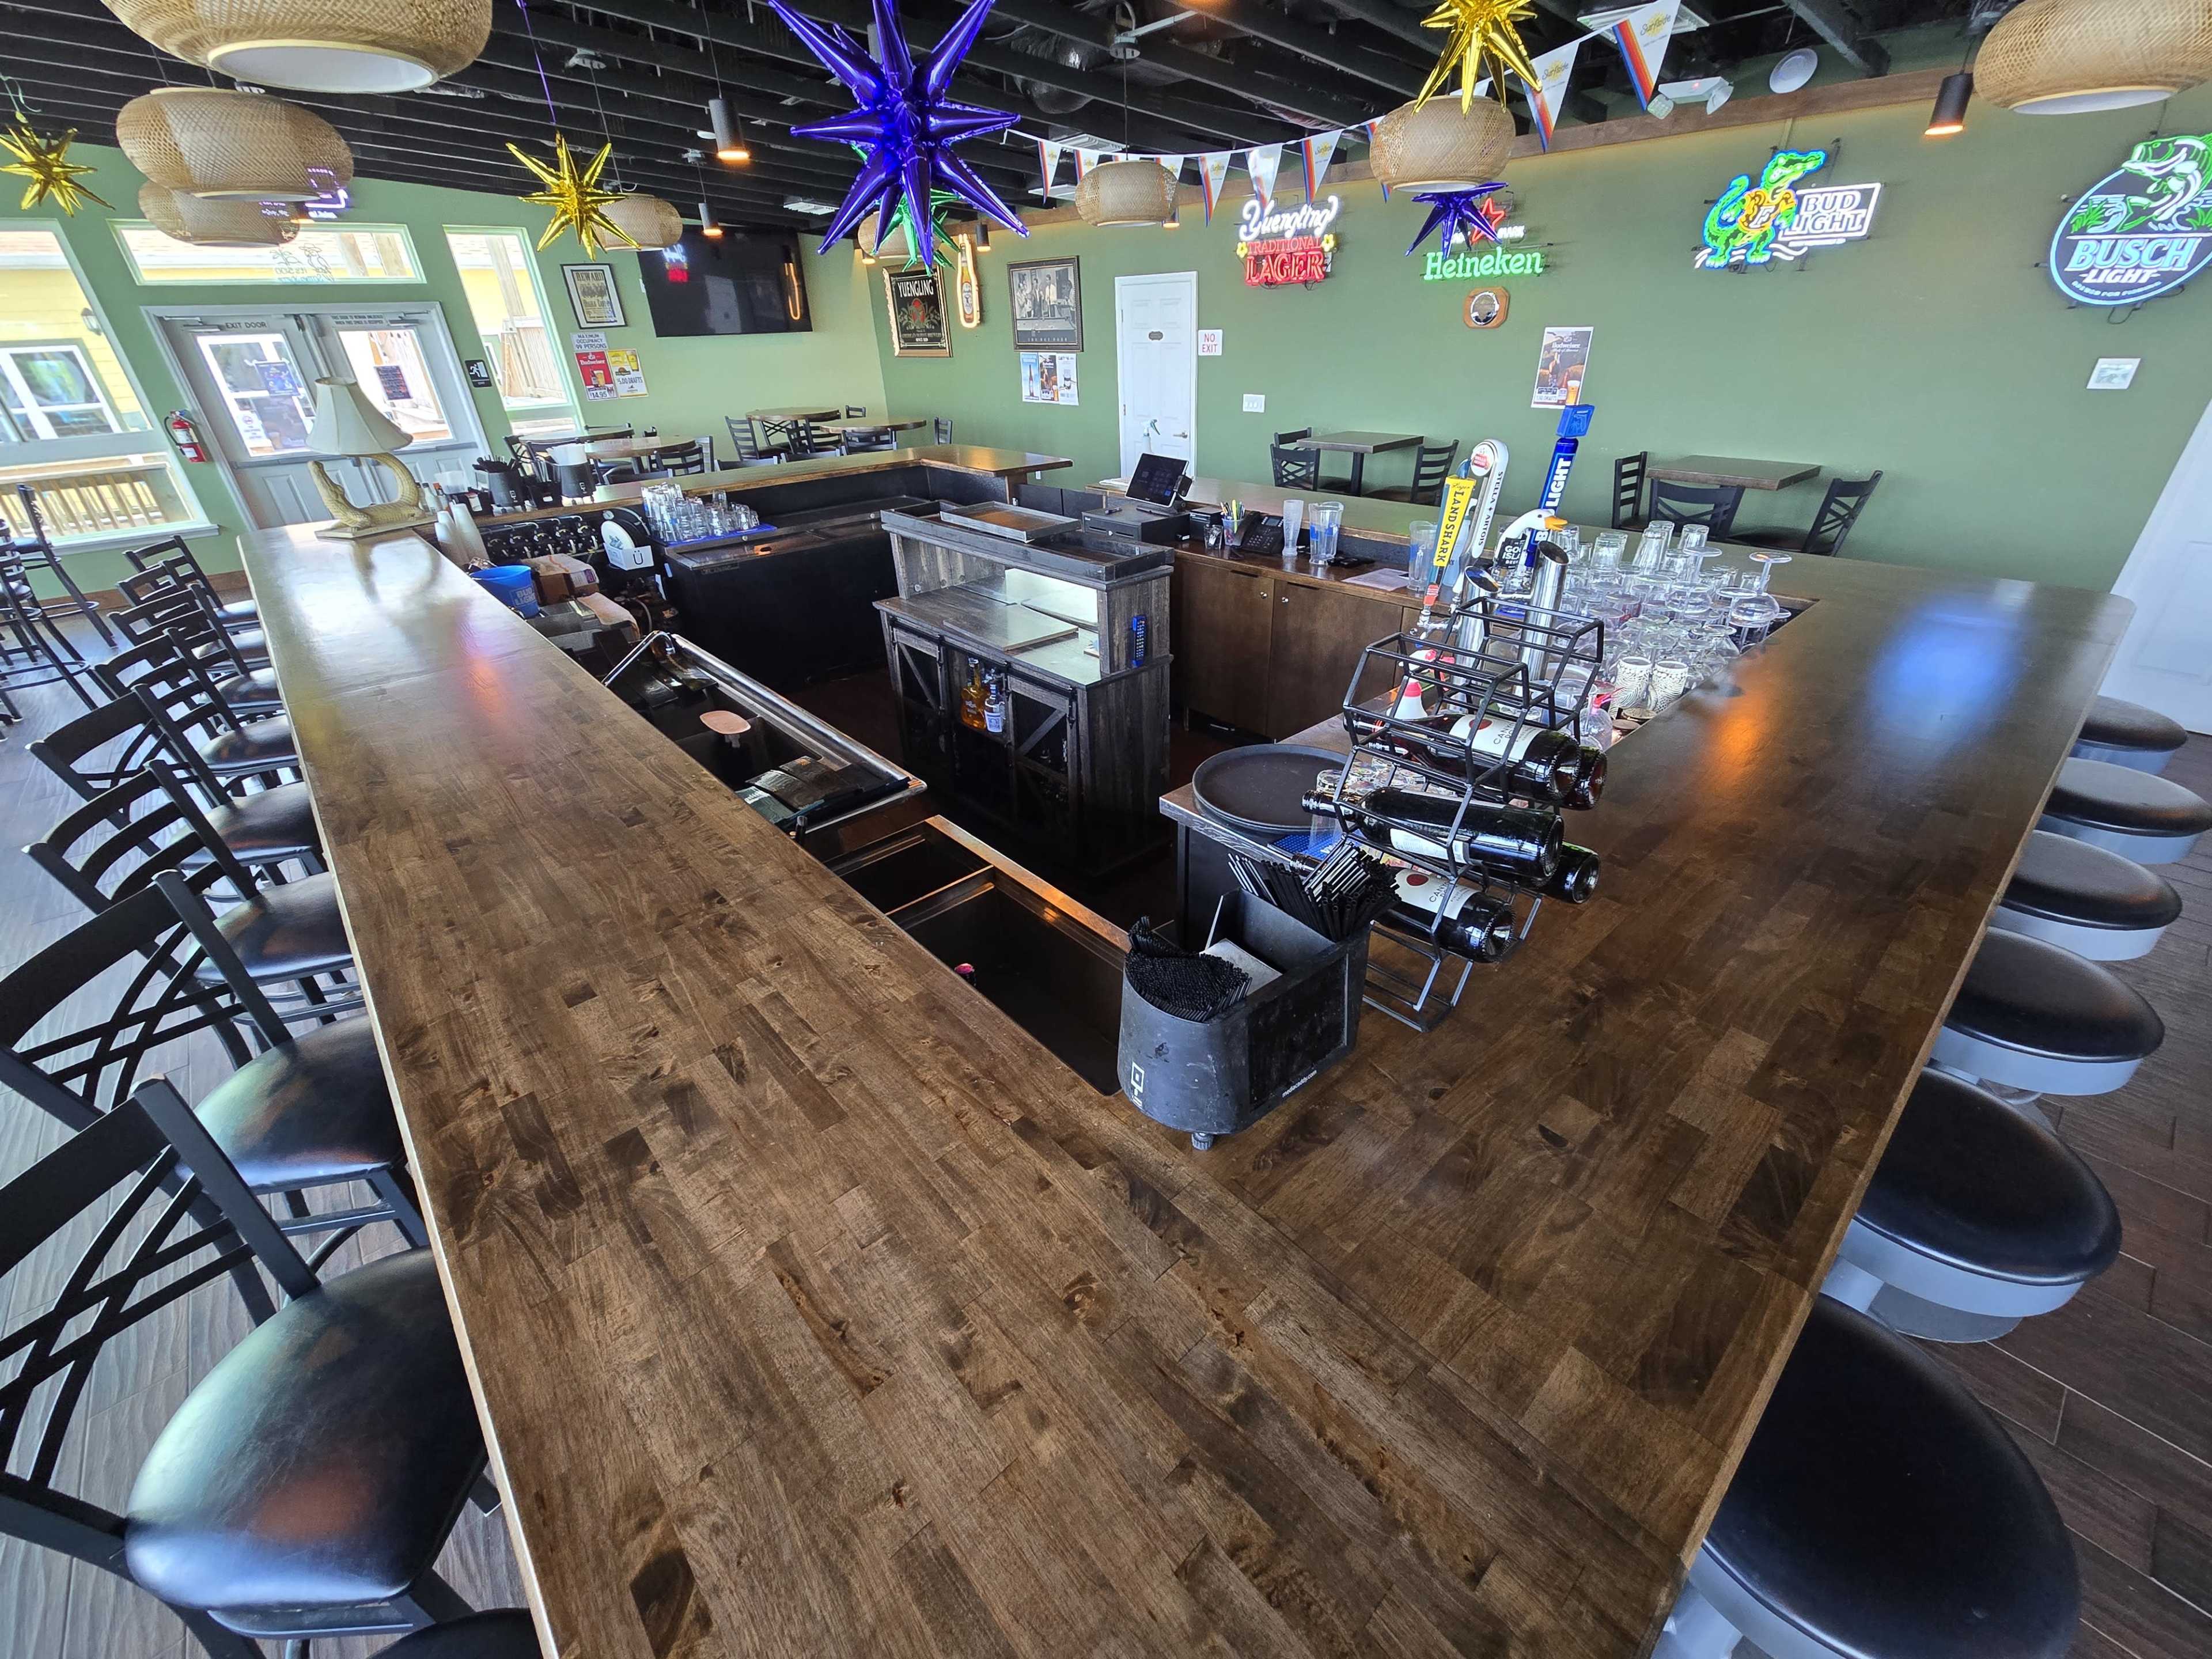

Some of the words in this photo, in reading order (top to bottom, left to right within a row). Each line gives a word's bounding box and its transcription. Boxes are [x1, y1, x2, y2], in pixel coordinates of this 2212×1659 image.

[1800, 191, 1861, 215] BUD
[1239, 195, 1339, 241] Yuengling
[1785, 209, 1868, 235] LIGHT
[1247, 236, 1322, 255] TRADITIONAL
[2064, 237, 2202, 271] BUSCH
[576, 272, 604, 281] REWARD
[1245, 251, 1325, 285] LAGER
[1423, 246, 1544, 281] Heineken
[2081, 268, 2159, 283] LIGHT
[897, 279, 934, 297] YUENGLING
[1202, 343, 1218, 353] EXIT
[1204, 333, 1215, 342] NO
[1490, 471, 1503, 503] STELLA
[1545, 457, 1571, 507] LIGHT
[1437, 491, 1464, 562] LANDSHARK
[1479, 515, 1491, 546] ARTOIS
[516, 587, 532, 599] BUD
[1282, 1070, 1317, 1098] mediacaddy.com
